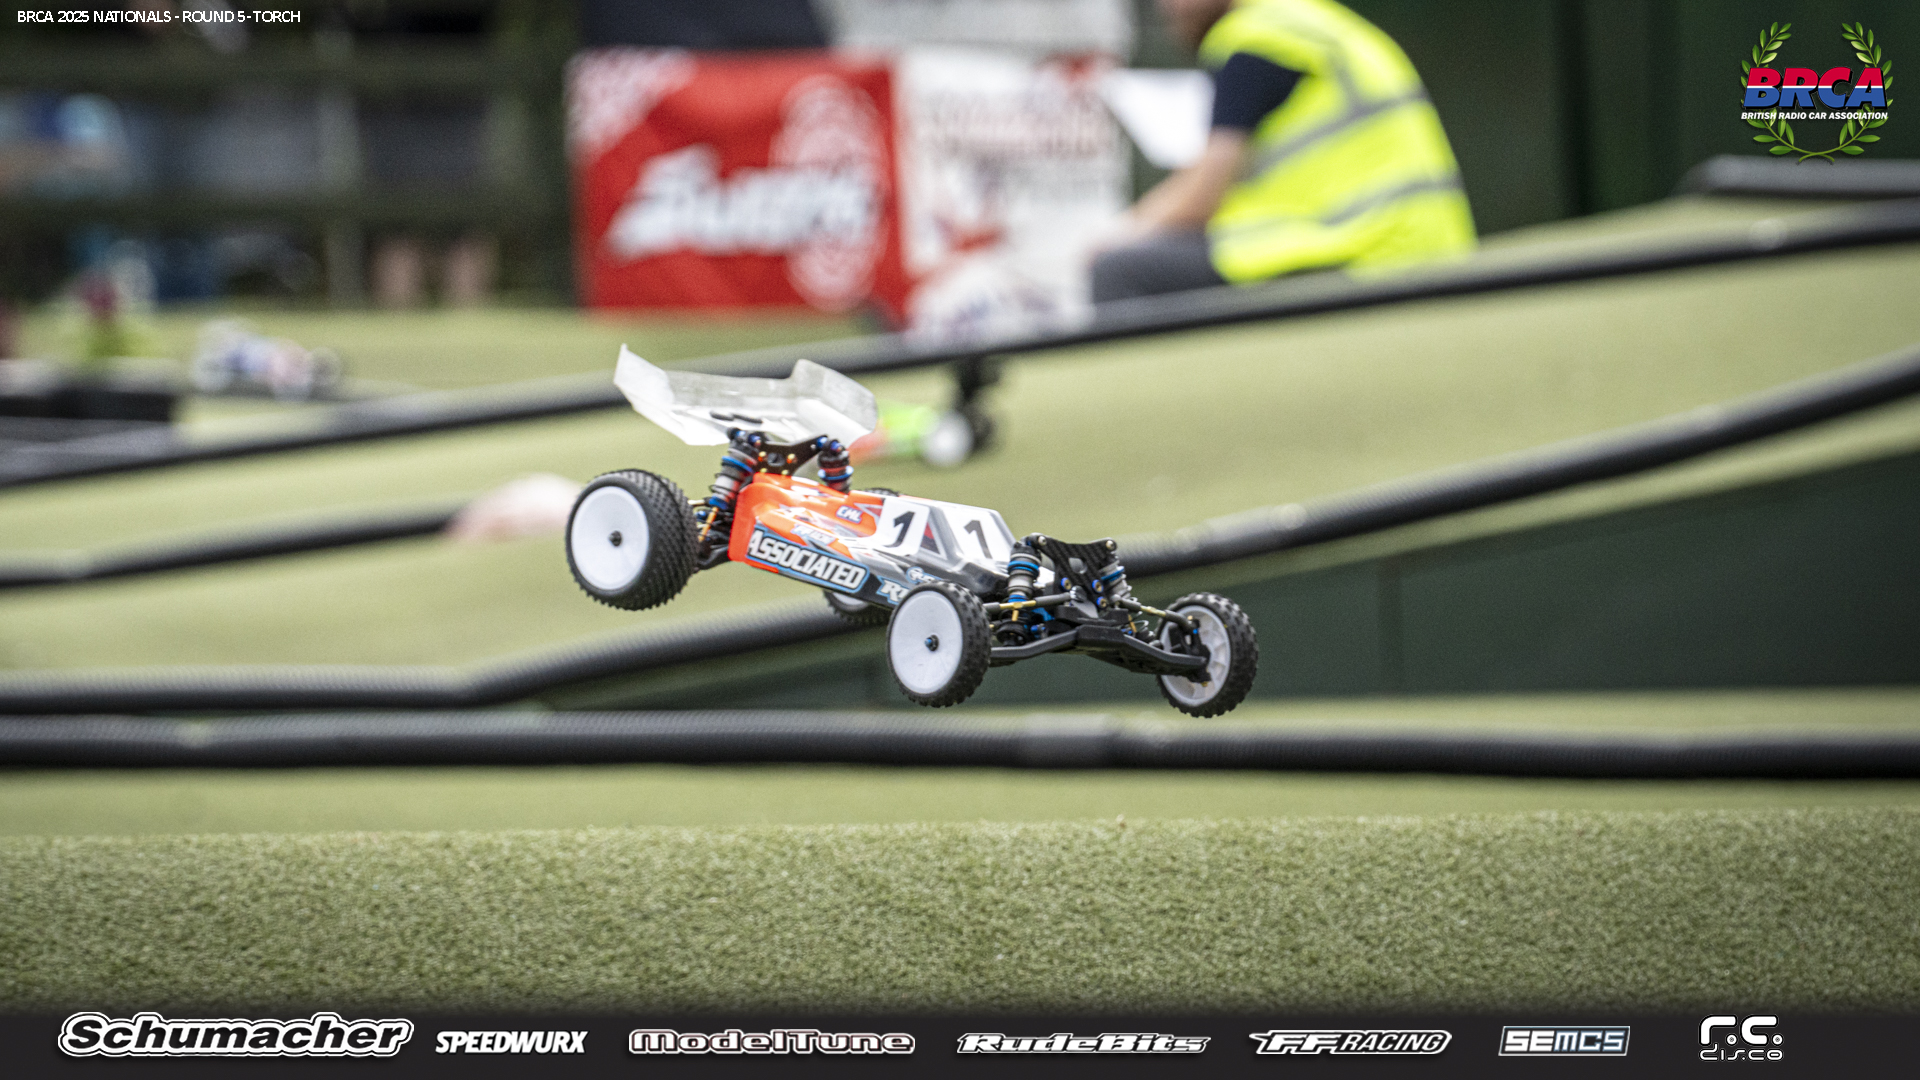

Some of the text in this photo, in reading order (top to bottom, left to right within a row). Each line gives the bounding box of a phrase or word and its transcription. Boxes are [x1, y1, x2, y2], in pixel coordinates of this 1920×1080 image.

[882, 510, 916, 548] 1
[963, 519, 994, 560] 1
[748, 529, 868, 590] ASSOCIATED
